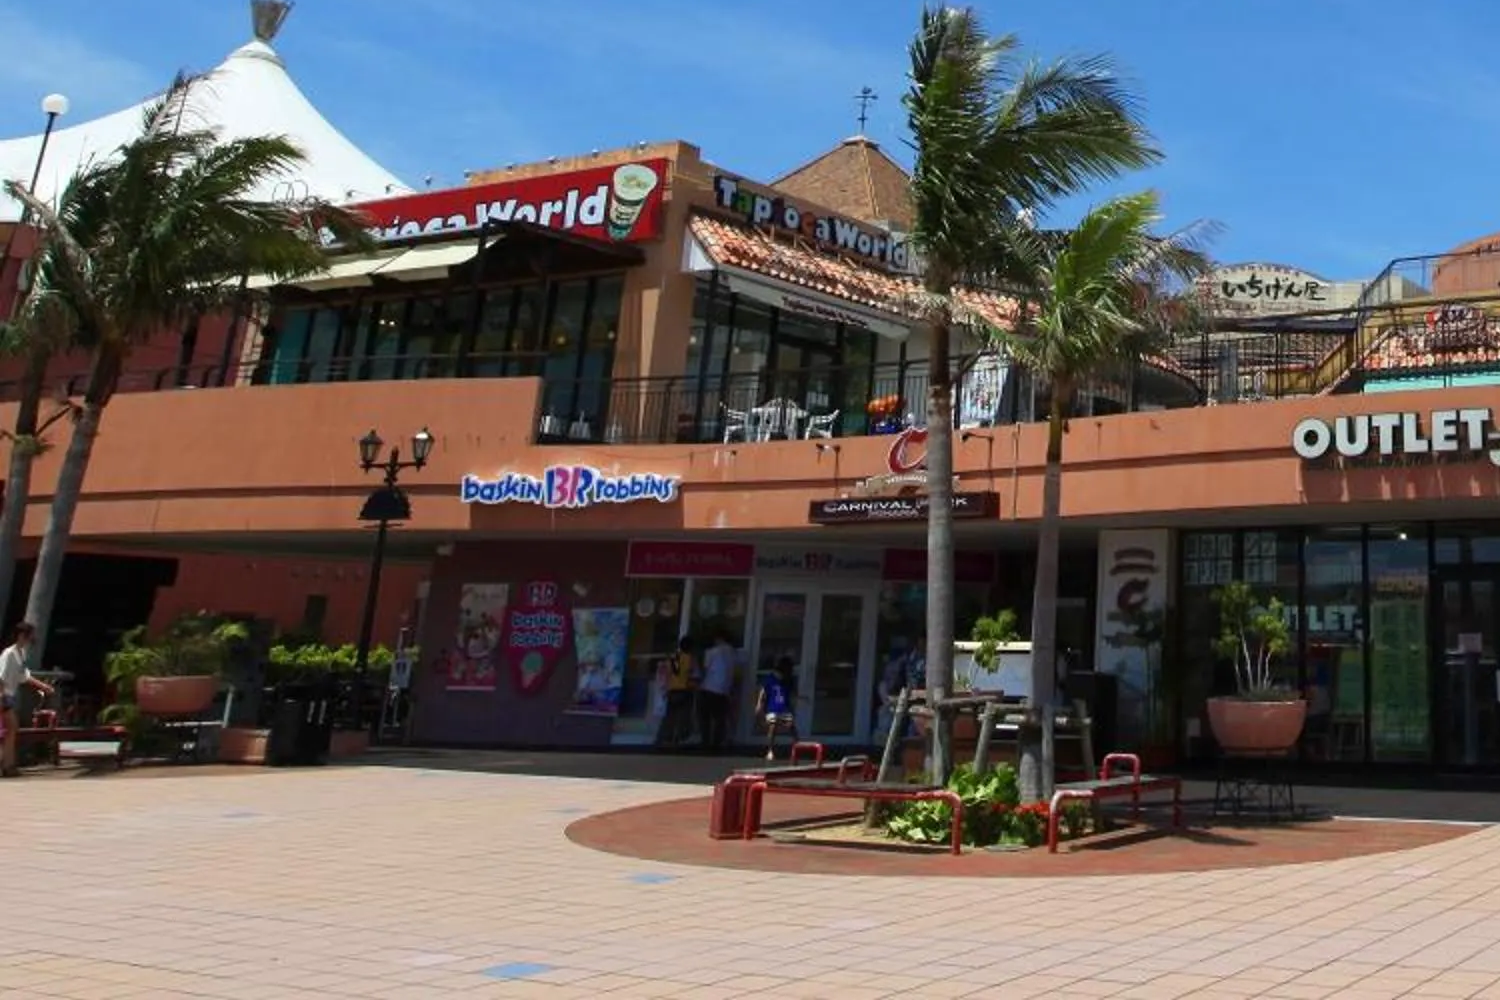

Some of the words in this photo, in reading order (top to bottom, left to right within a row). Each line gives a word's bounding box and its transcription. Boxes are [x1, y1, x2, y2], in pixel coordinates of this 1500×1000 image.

[476, 186, 609, 228] World
[834, 220, 909, 269] World
[1221, 272, 1326, 301] いちげん屋
[545, 467, 593, 506] BR
[596, 475, 677, 501] robbins
[823, 500, 913, 513] CARNIVAL
